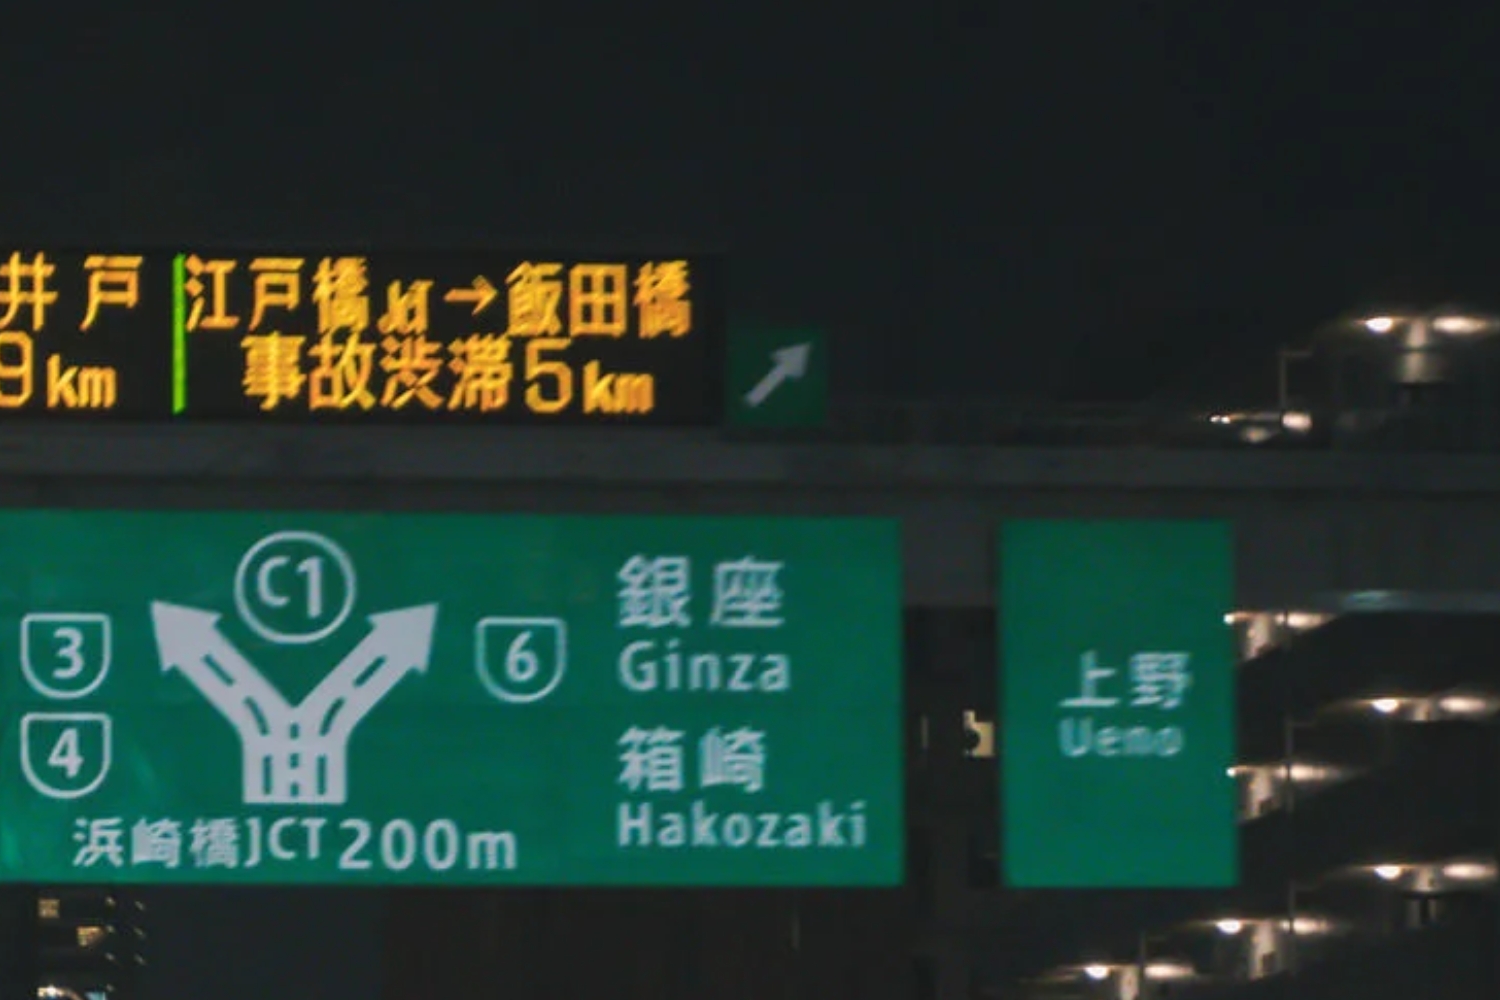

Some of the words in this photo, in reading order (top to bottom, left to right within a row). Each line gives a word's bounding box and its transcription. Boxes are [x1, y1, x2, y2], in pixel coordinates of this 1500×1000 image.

[505, 259, 692, 337] 飯田橋
[256, 556, 324, 619] C1
[617, 555, 785, 629] 銀座
[51, 627, 86, 680] 3
[506, 631, 539, 683] 6
[619, 640, 791, 692] Ginza
[1059, 650, 1193, 709] 上野
[47, 728, 85, 779] 4
[616, 725, 768, 793] 箱崎
[337, 819, 518, 871] 200m
[616, 801, 868, 849] Hakozaki
